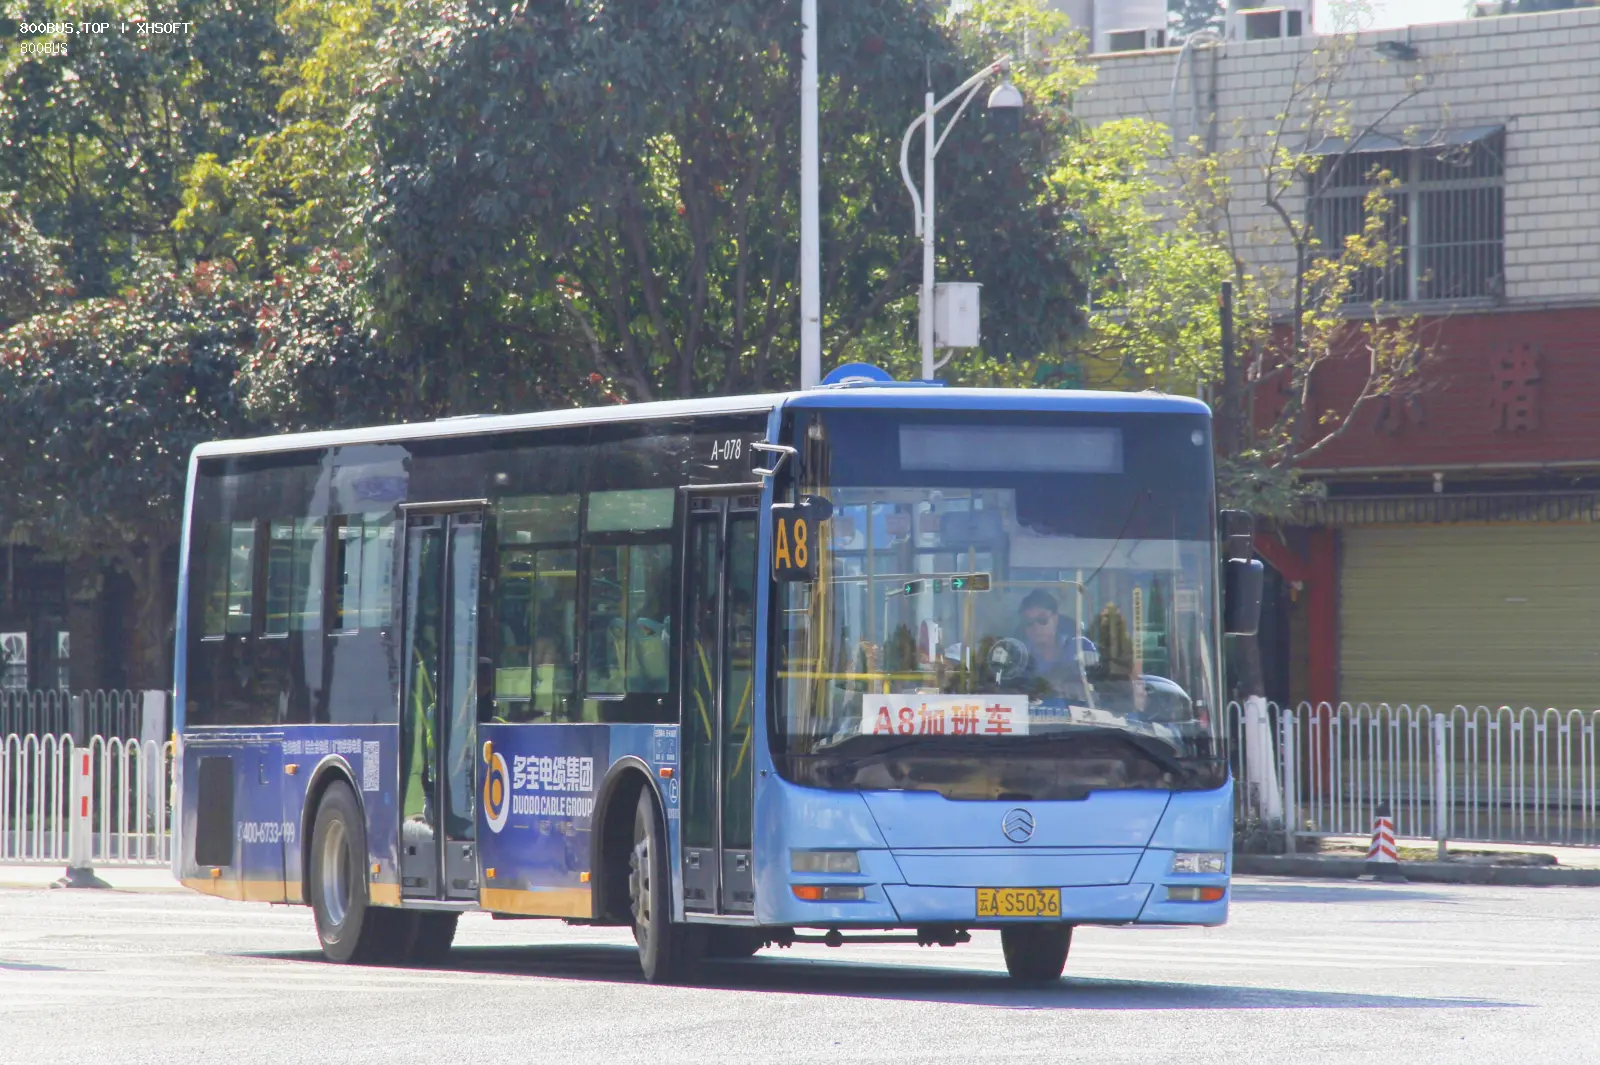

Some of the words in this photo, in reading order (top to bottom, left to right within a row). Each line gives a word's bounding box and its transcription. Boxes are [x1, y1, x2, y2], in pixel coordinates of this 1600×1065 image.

[711, 439, 742, 461] A-078
[775, 518, 808, 569] A8
[873, 702, 1013, 736] A8加班车
[512, 754, 594, 792] 多宝电缆集团
[512, 795, 540, 815] DUOBO
[540, 796, 566, 816] CABLE
[566, 798, 593, 818] GROUP
